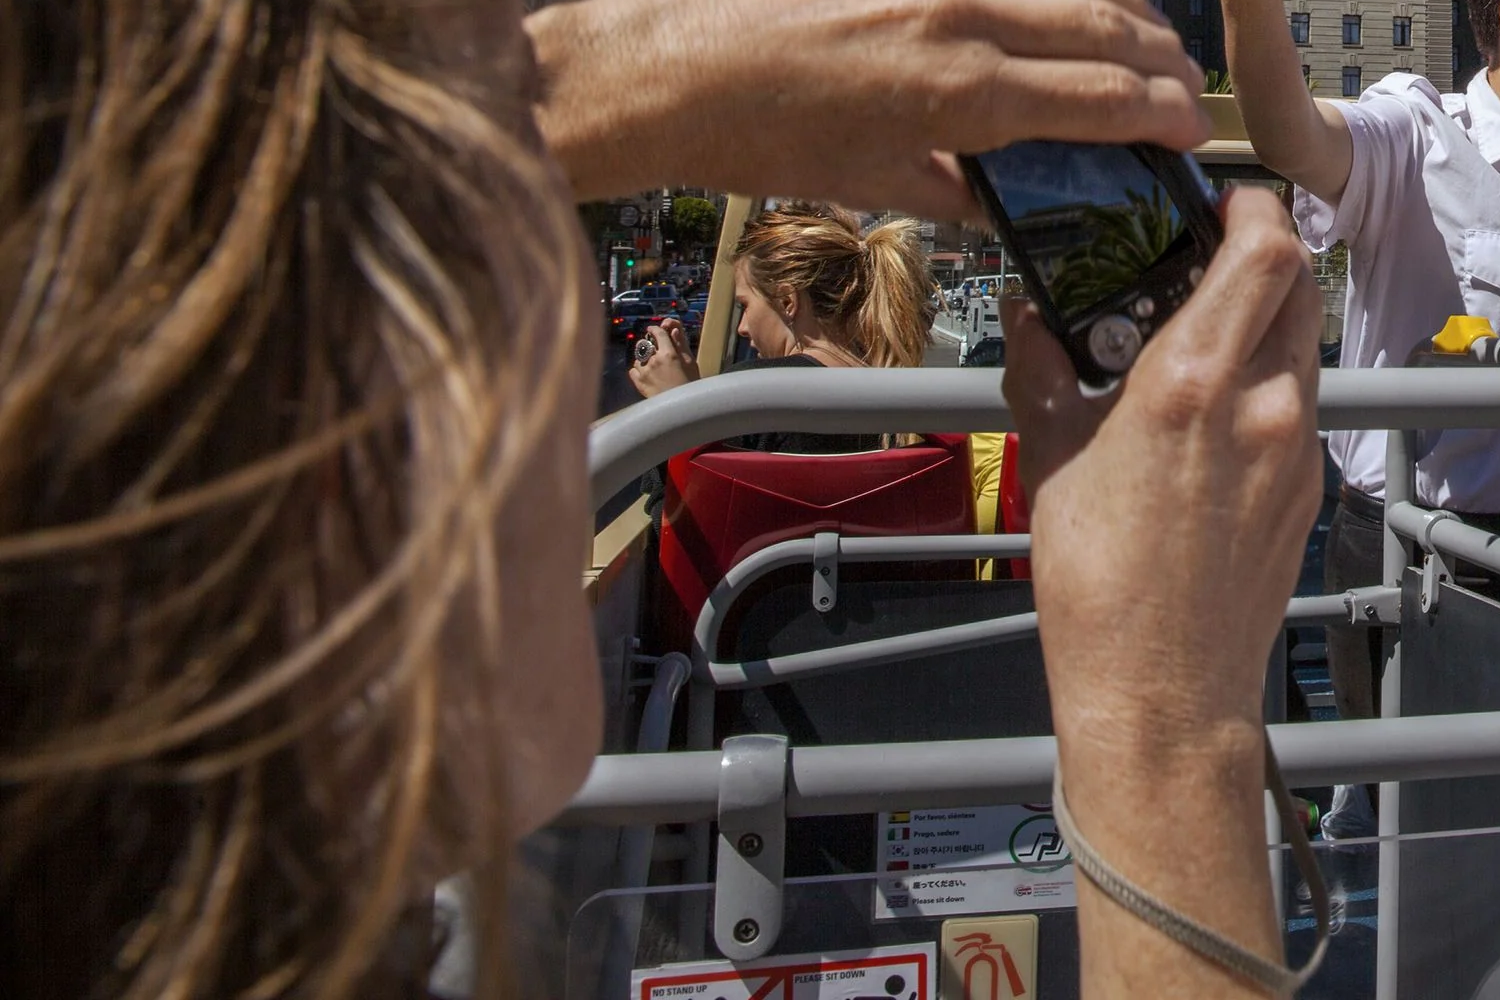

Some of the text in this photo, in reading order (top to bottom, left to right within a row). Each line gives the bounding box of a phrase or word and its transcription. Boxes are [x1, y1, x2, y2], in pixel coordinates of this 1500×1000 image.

[927, 813, 947, 821] favor,
[912, 895, 965, 905] Please sit down
[794, 970, 866, 984] PLEASE SIT DOWN
[652, 984, 708, 997] NO STAND UP
